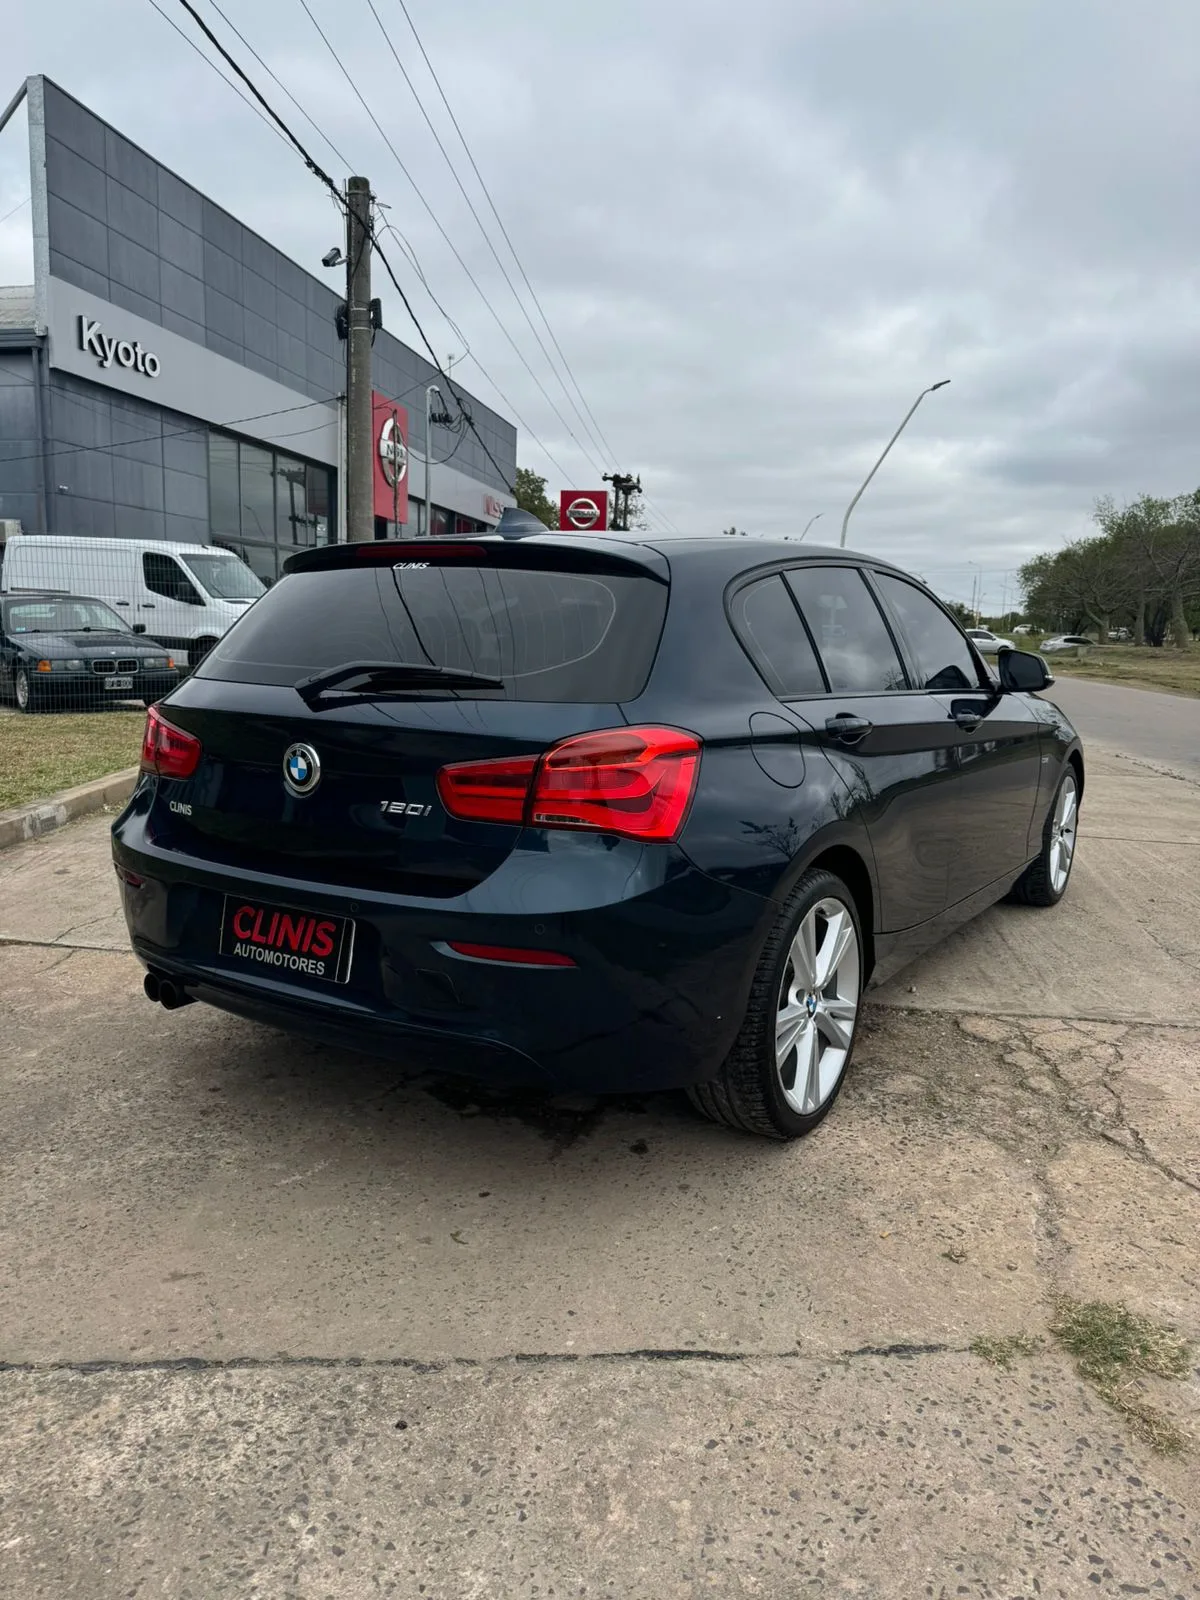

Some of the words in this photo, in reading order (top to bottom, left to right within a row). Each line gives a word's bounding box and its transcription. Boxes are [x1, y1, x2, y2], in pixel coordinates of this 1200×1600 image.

[77, 315, 161, 378] Kyoto
[392, 562, 430, 570] CLINIS
[169, 800, 192, 816] CLINIS
[380, 800, 432, 816] 120i
[233, 905, 336, 957] CLINIS
[233, 942, 325, 975] AUTOMOTORES
